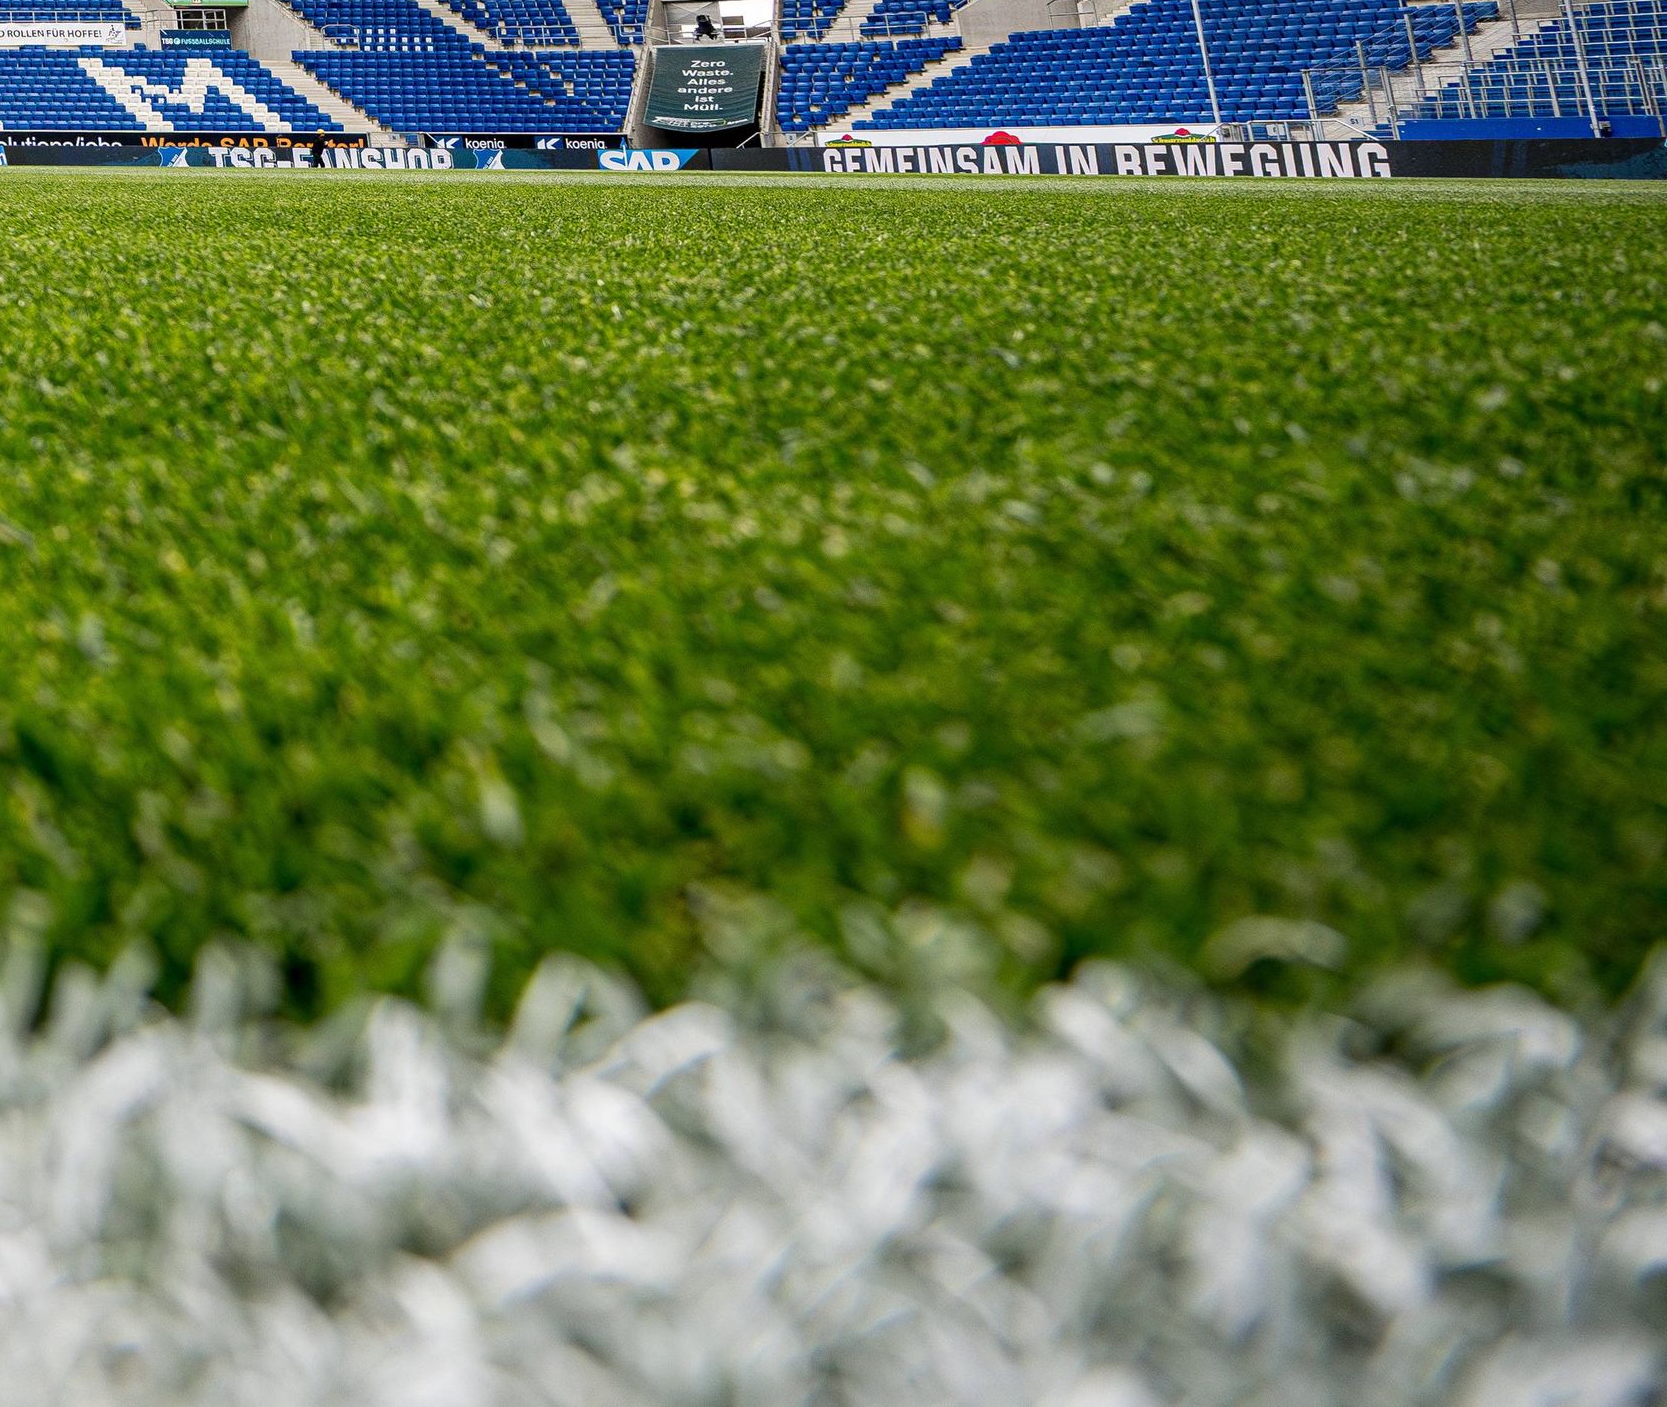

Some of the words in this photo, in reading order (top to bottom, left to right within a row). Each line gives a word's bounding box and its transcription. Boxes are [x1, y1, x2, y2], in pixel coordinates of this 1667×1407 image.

[7, 29, 45, 38] ROLLEN
[46, 28, 66, 38] FÜR
[68, 29, 102, 38] HOFFE!
[690, 60, 726, 68] Zero
[682, 69, 734, 77] Waste.
[677, 86, 733, 94] andere
[695, 95, 714, 103] ist
[683, 103, 723, 111] Müll.
[600, 151, 680, 171] SAP
[1055, 145, 1097, 175] IN
[1115, 143, 1391, 178] BEWEGUNG
